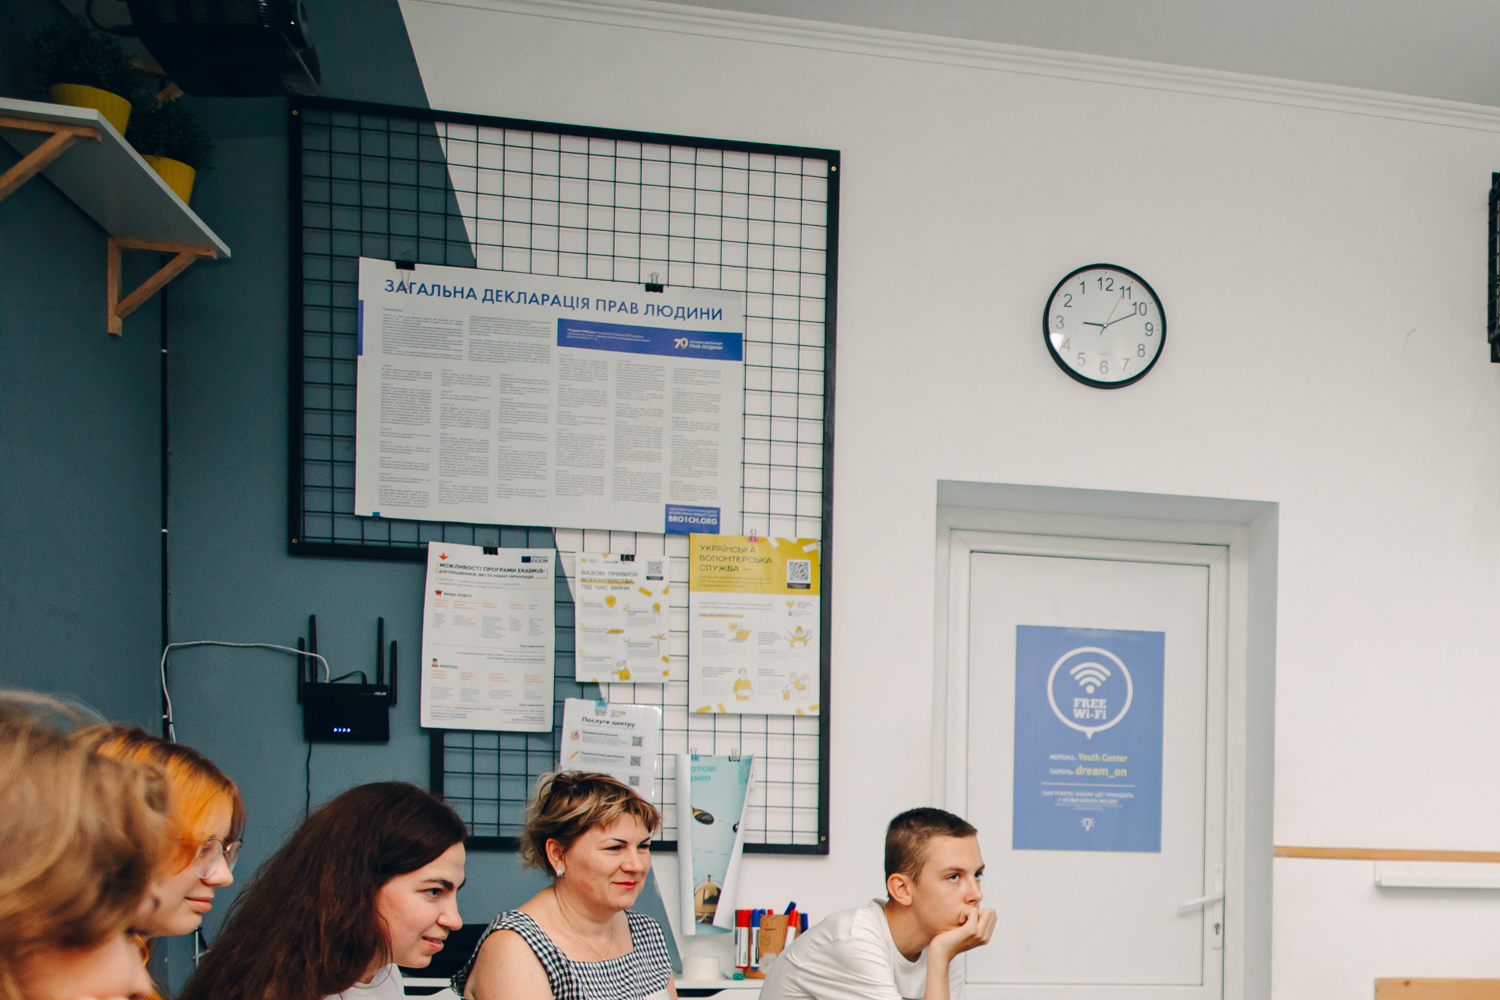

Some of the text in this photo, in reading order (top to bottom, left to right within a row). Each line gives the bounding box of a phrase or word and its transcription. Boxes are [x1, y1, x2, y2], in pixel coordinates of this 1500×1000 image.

[1079, 280, 1086, 295] 1
[1097, 276, 1115, 292] 12
[384, 279, 723, 321] ЗАГАЛЬНА ДЕКЛАРАЦІЯ ПРАВ ЛЮДИНИ
[1119, 285, 1132, 300] 11
[1063, 293, 1073, 308] 2
[1131, 301, 1148, 316] 10
[1055, 315, 1065, 330] 3
[1145, 322, 1154, 337] 9
[674, 337, 689, 349] 70
[1062, 337, 1072, 352] 4
[1137, 343, 1146, 358] 8
[1077, 352, 1086, 367] 5
[1121, 357, 1131, 372] 7
[1099, 360, 1109, 375] 6
[699, 544, 757, 554] УКРАЇНСЬКА
[699, 554, 773, 564] ВОЛОНТЕРСЬКА
[439, 563, 482, 572] МОЖЛИВОСТІ
[581, 569, 605, 577] БАЗОВІ
[699, 564, 740, 572] СЛУЖБА
[1073, 697, 1107, 709] FREE
[1073, 708, 1107, 720] Wi-Fi
[582, 716, 636, 729] Послуги центру
[1078, 752, 1101, 762] Youth
[1102, 753, 1128, 763] Center
[690, 765, 717, 773] ОТОВІ
[1075, 764, 1127, 779] dream_on
